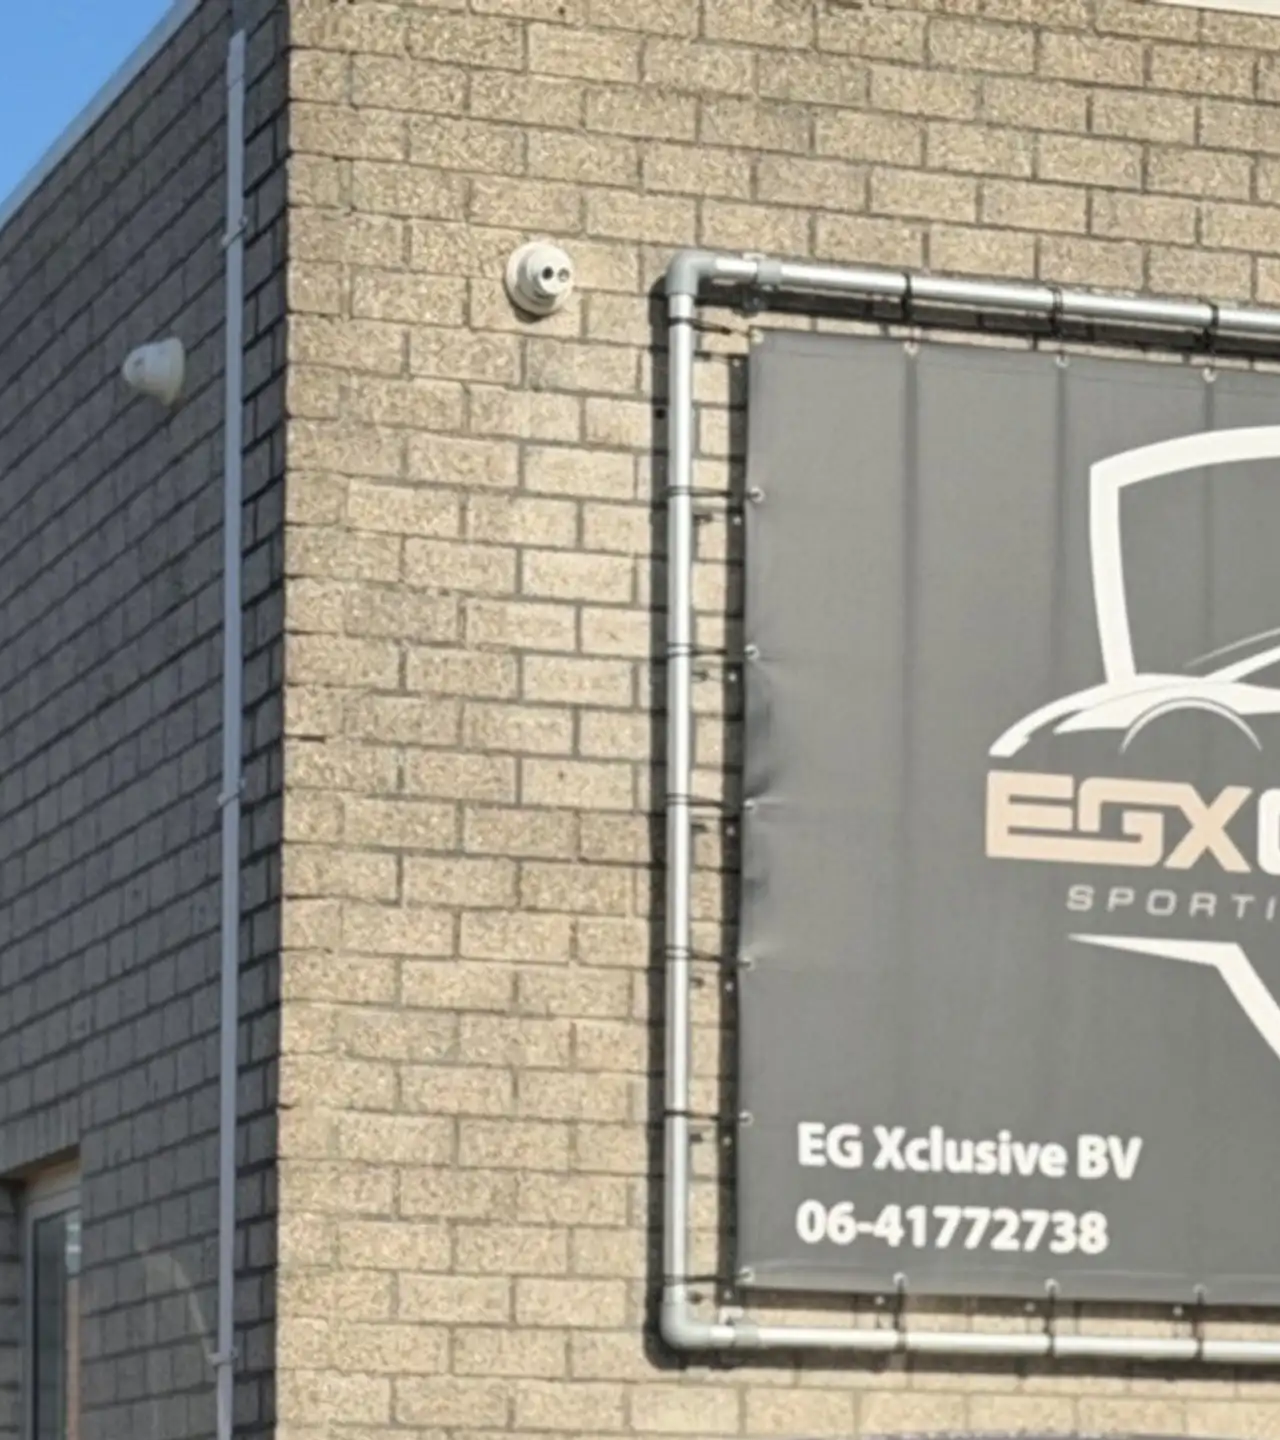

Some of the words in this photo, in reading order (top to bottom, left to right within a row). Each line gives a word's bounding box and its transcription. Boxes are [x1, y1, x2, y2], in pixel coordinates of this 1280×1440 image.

[798, 1121, 863, 1168] EG
[873, 1125, 1068, 1178] Xclusive
[1077, 1134, 1142, 1179] BV
[795, 1199, 1109, 1255] 06-41772738
